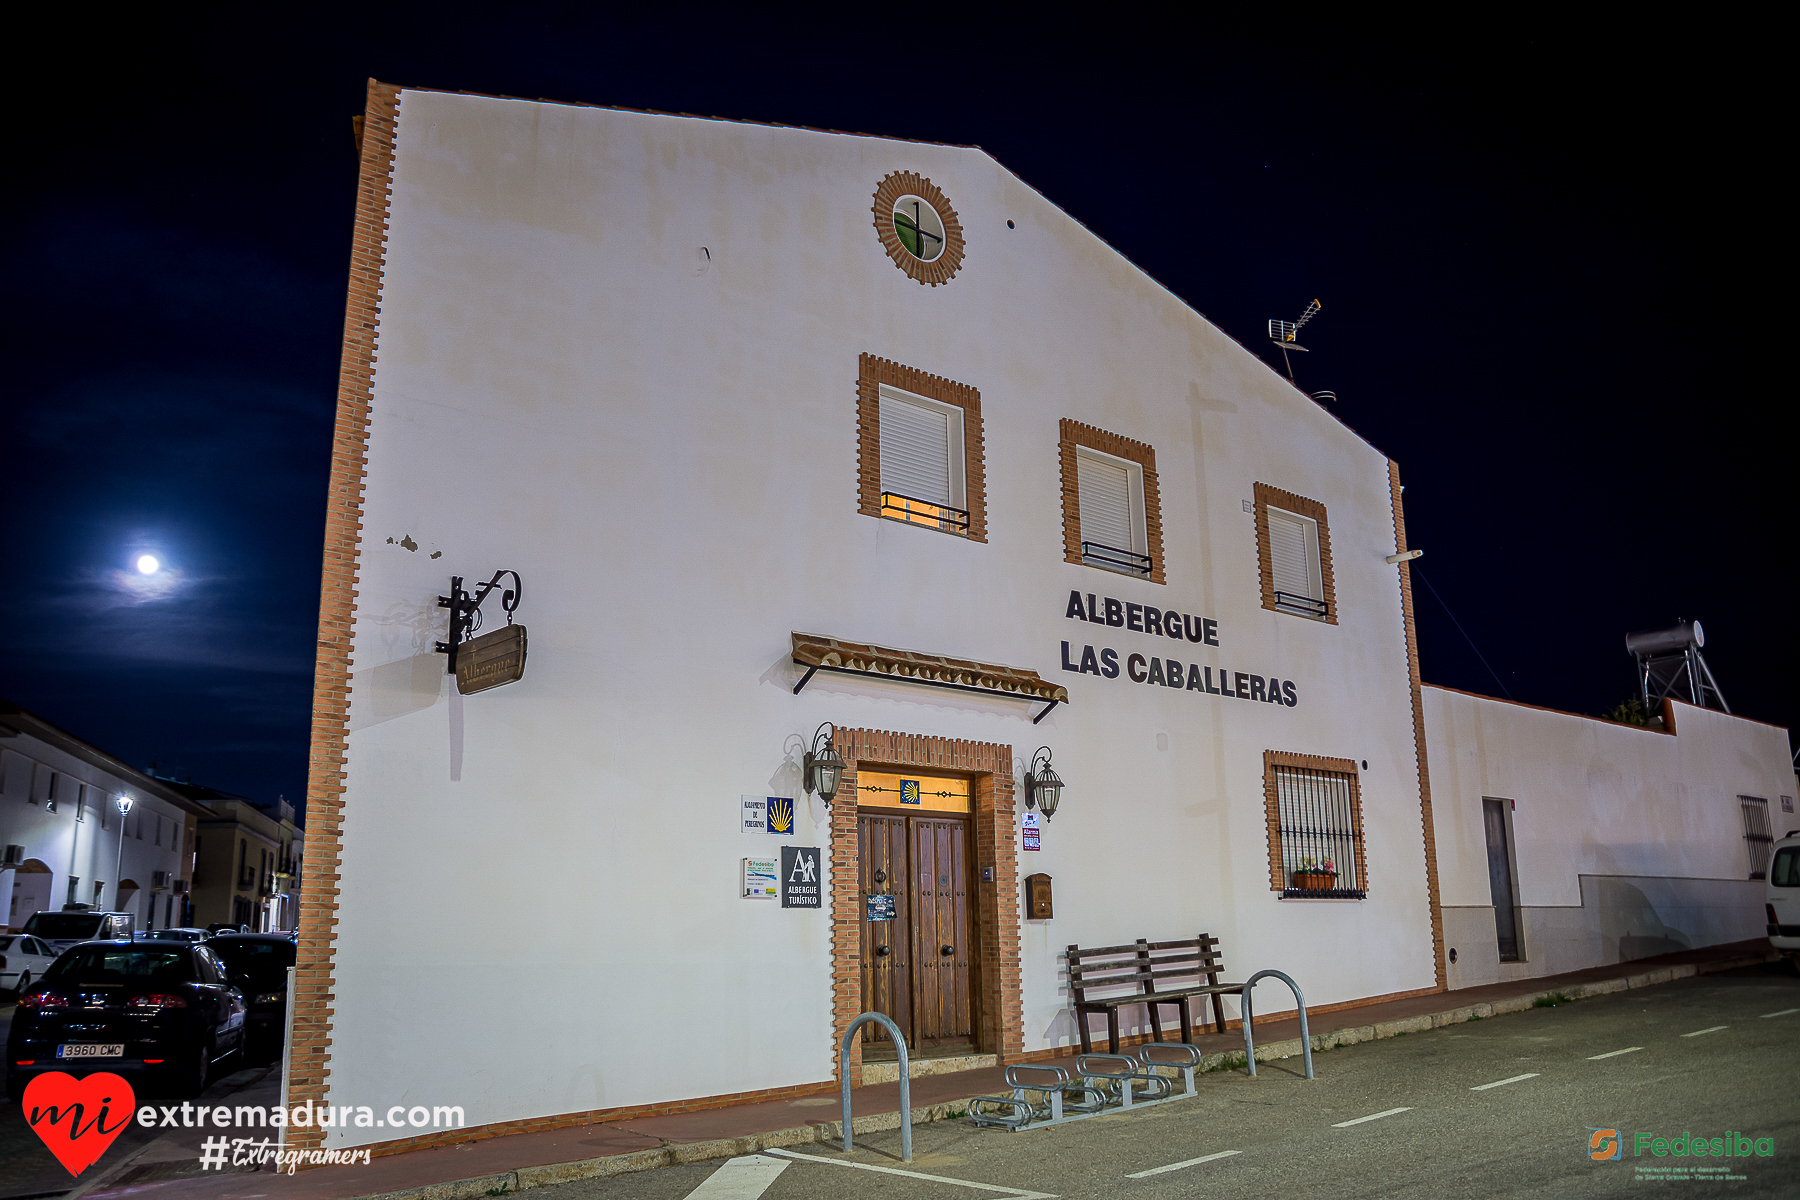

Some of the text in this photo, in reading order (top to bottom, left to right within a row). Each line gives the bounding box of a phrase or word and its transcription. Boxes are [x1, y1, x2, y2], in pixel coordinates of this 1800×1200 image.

[1065, 589, 1220, 647] ALBERGUE
[1060, 640, 1298, 708] LAS CABALLERAS
[788, 886, 818, 894] ALBERGUE
[788, 896, 818, 905] TURÍSTICO
[66, 1045, 121, 1056] 3960 CMC
